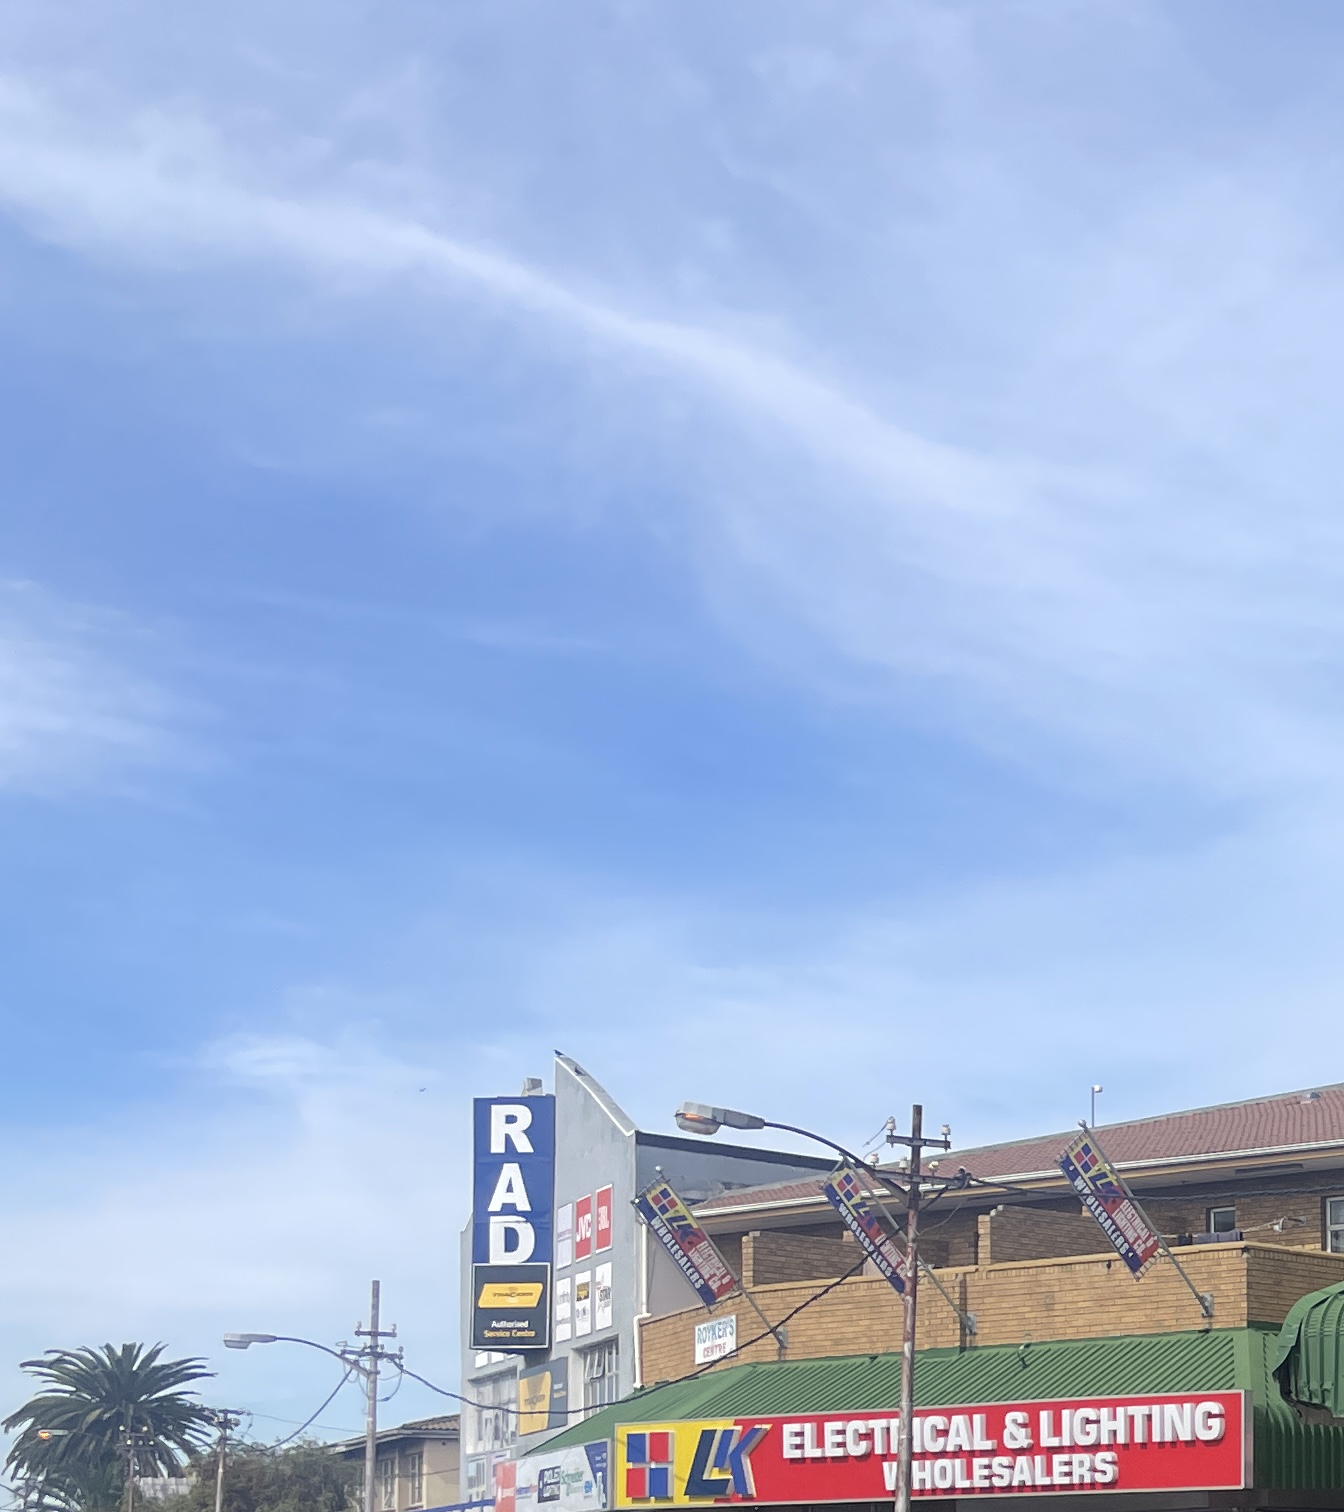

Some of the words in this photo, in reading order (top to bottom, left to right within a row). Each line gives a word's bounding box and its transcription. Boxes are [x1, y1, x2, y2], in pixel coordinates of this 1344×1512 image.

[488, 1104, 536, 1264] RAD
[576, 1213, 592, 1243] JVC
[650, 1215, 705, 1290] WHOLESALERS
[703, 1342, 727, 1358] CENTRE
[1003, 1411, 1034, 1450] &
[1040, 1401, 1225, 1447] LIGHTING
